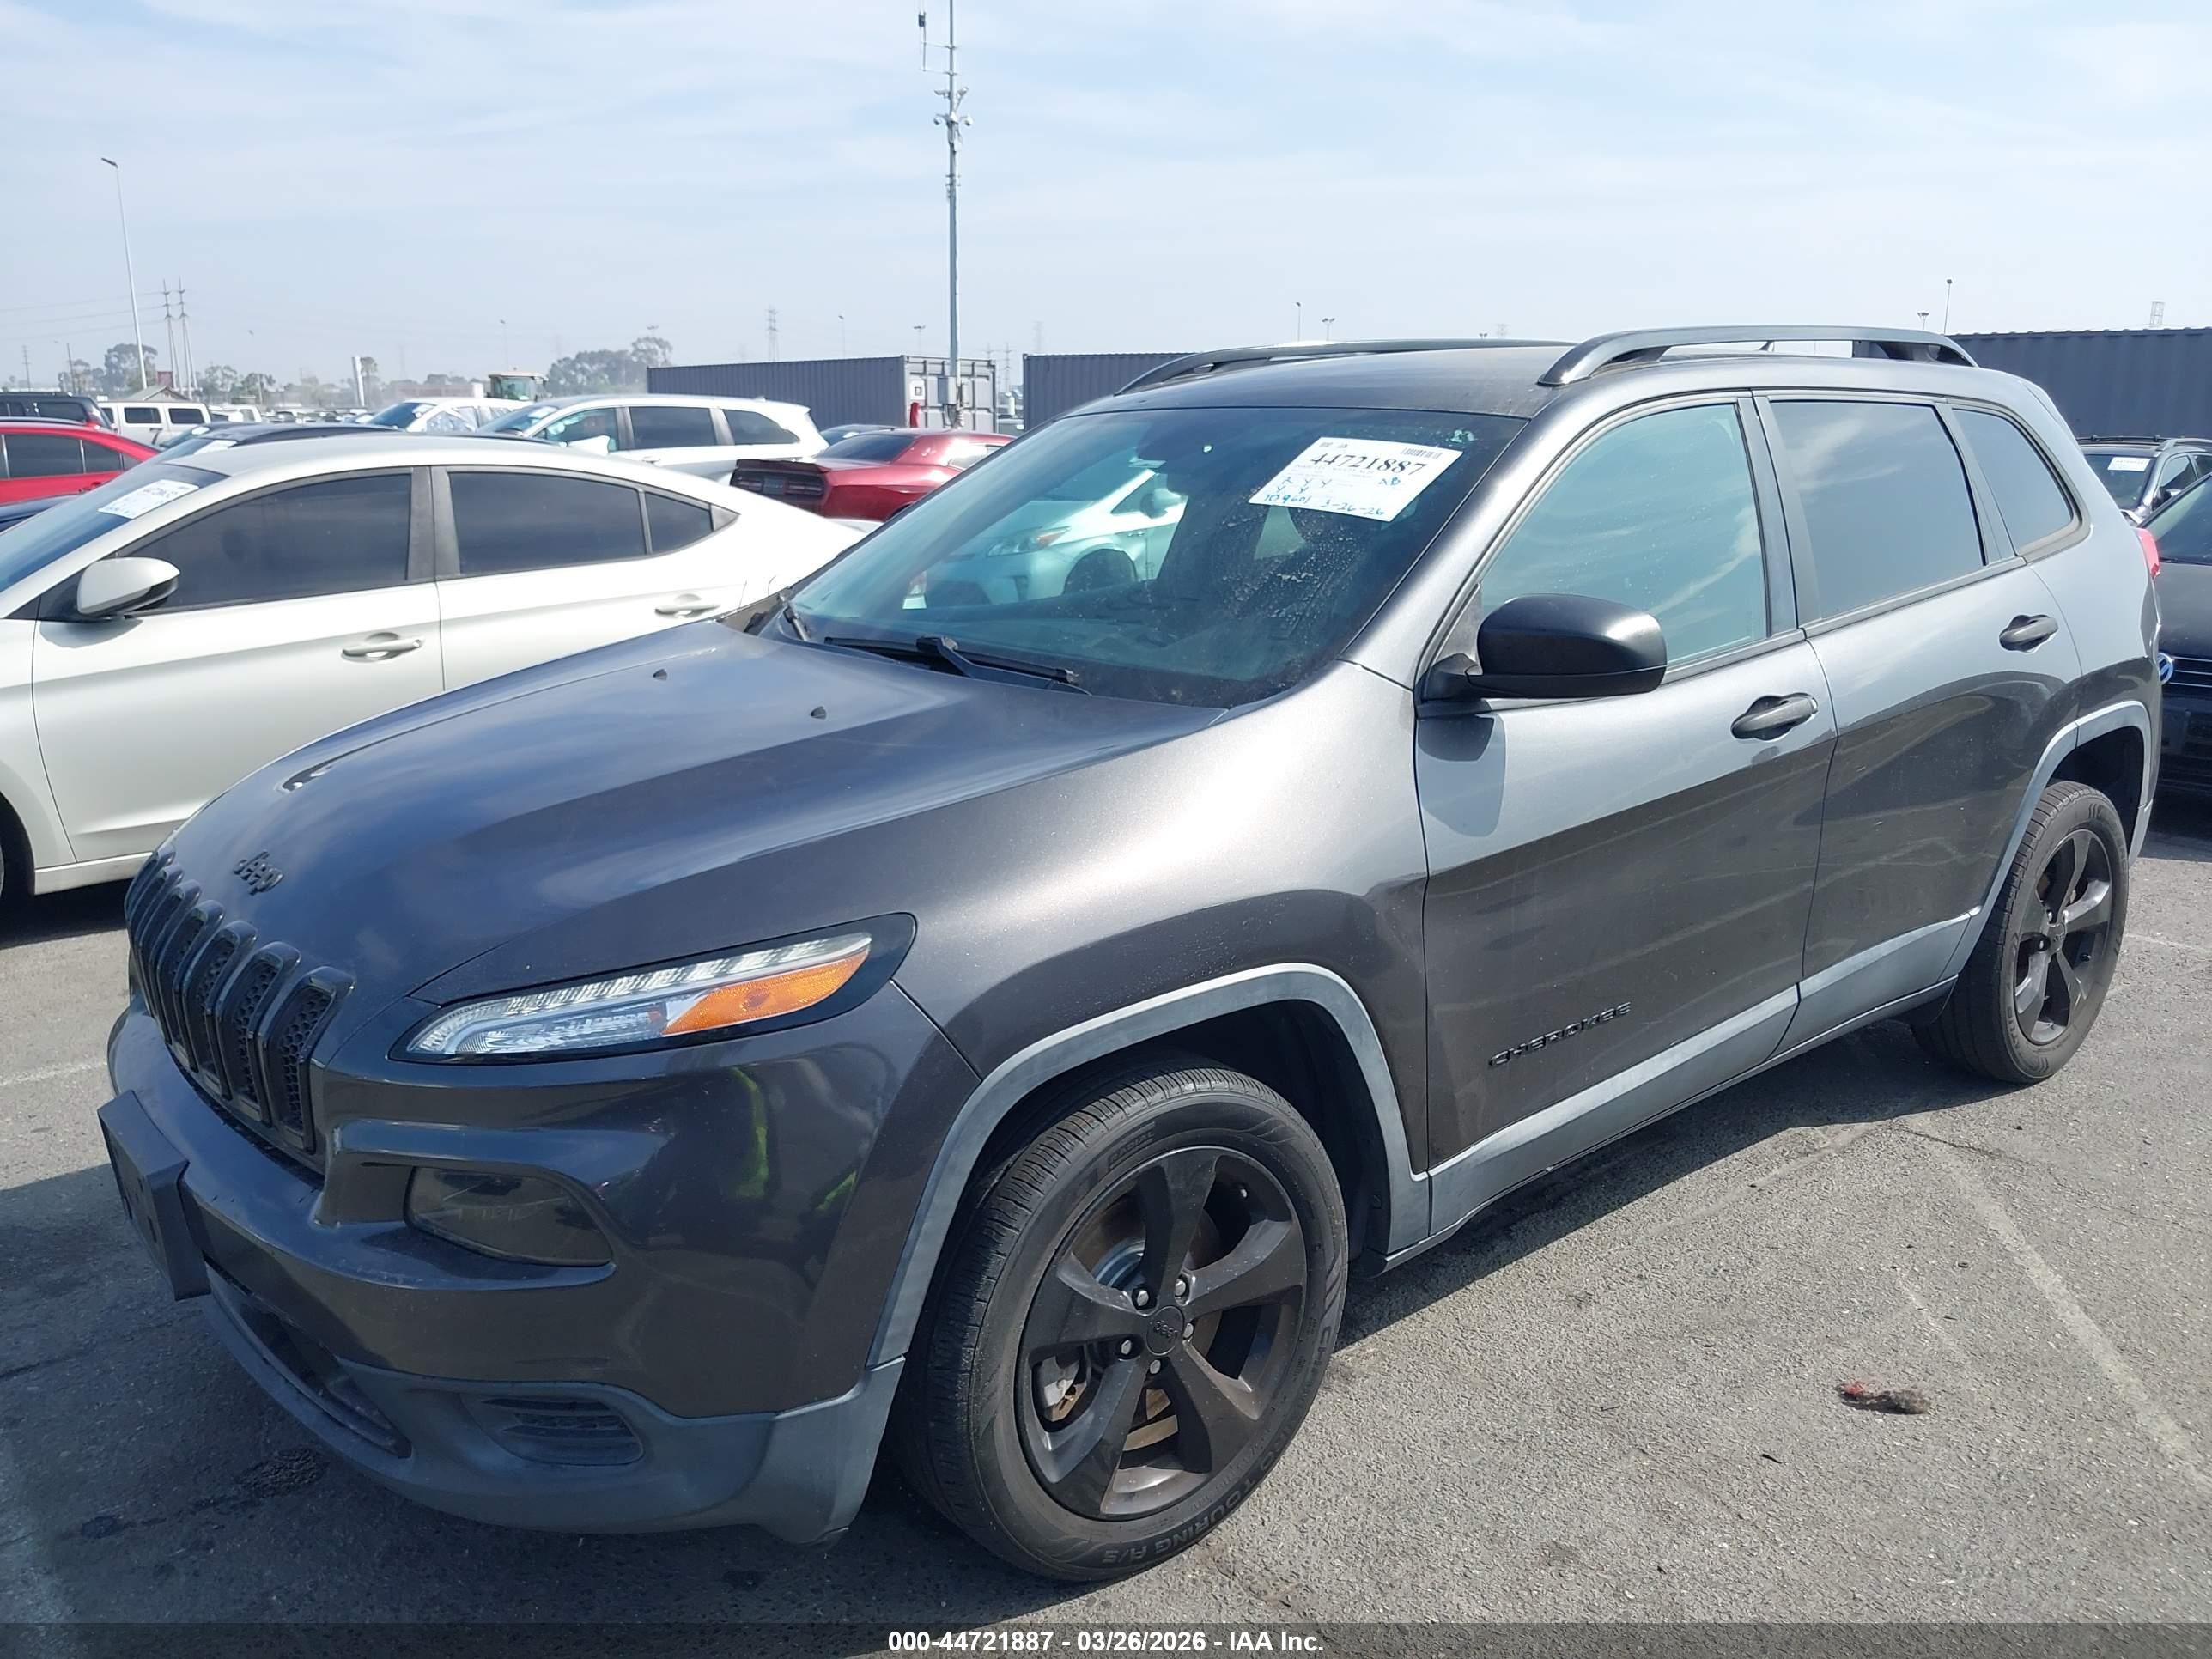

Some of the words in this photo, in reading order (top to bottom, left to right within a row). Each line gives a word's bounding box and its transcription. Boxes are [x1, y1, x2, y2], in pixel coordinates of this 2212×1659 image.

[1310, 453, 1428, 475] 44721887
[234, 850, 283, 896] Jeep
[1489, 1001, 1631, 1066] CHEROKEE
[1103, 1547, 1147, 1564] A/S
